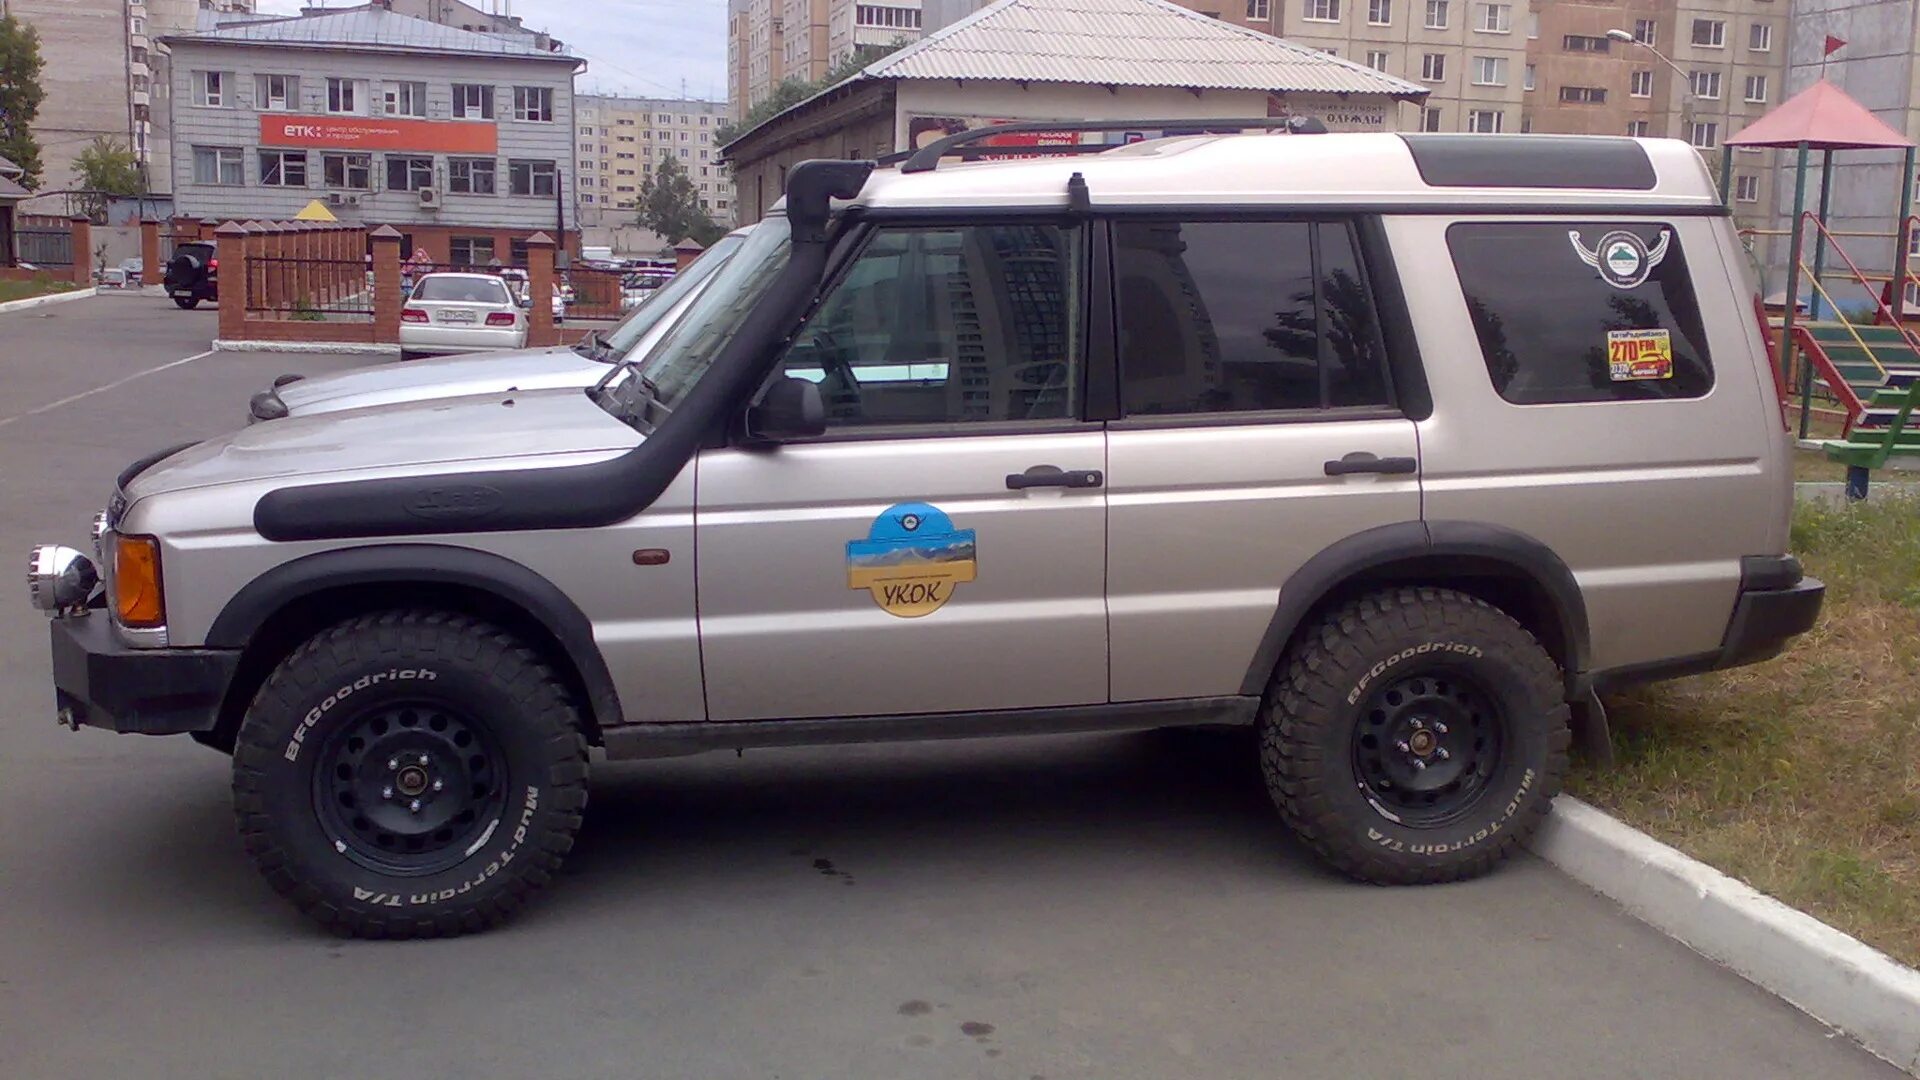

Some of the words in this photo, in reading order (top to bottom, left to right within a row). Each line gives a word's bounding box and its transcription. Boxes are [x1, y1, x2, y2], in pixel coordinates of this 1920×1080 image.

[1326, 113, 1382, 124] ОДЕЖДЫ
[1611, 341, 1639, 362] 270
[1639, 339, 1656, 351] FM
[1347, 641, 1483, 705] BFGoodrich
[284, 668, 438, 763] BFGoodrich
[1367, 827, 1404, 853] T/A
[353, 885, 402, 907] T/A
